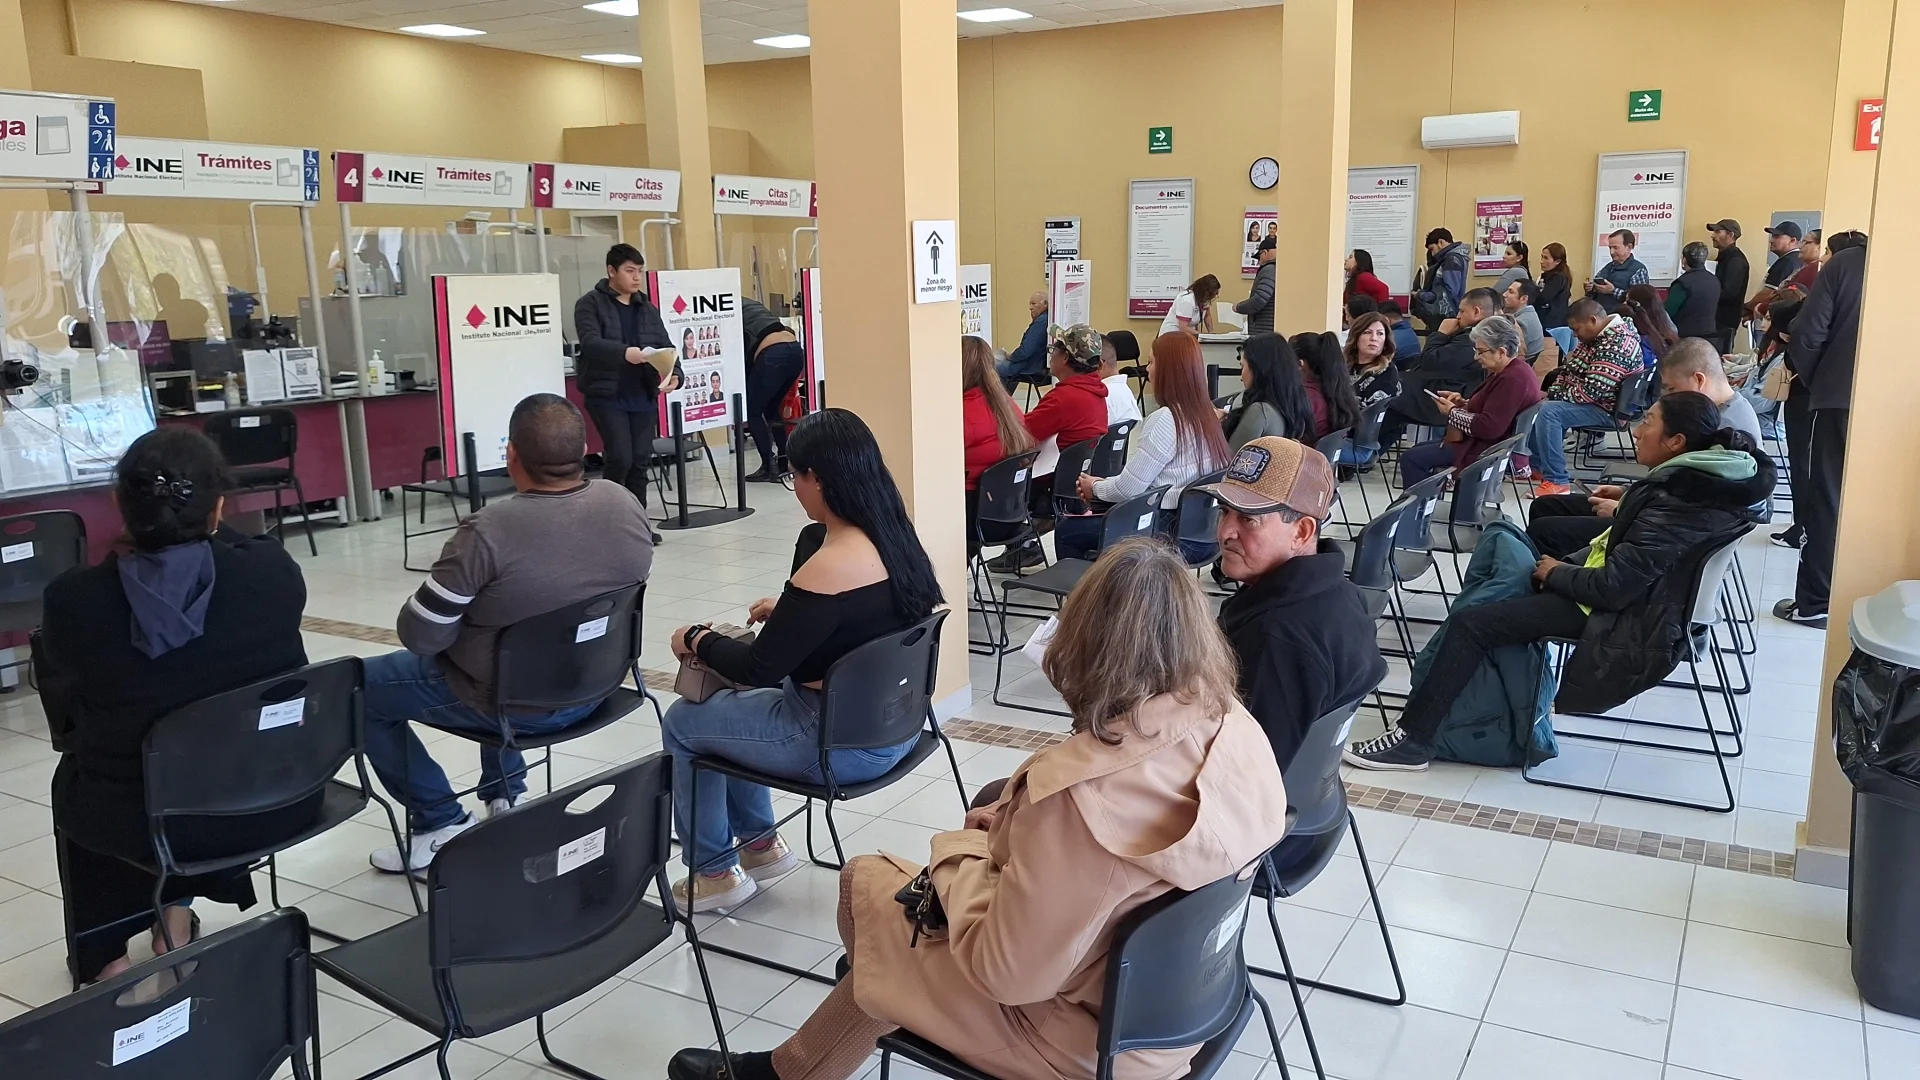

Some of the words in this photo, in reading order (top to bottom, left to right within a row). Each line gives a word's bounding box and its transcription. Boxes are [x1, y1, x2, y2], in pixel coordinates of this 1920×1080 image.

[136, 157, 183, 173] INE
[197, 153, 272, 170] Trámites
[344, 168, 358, 187] 4
[388, 169, 424, 184] INE
[437, 166, 492, 181] Trámites
[1646, 172, 1674, 181] INE
[539, 178, 550, 195] 3
[576, 181, 601, 192] INE
[635, 178, 663, 191] Citas
[1387, 178, 1408, 186] INE
[610, 192, 662, 201] programadas
[728, 188, 750, 200] INE
[768, 188, 788, 199] Citas
[750, 199, 788, 207] programadas
[1610, 211, 1672, 221] bienvenido
[1071, 264, 1085, 273] INE
[966, 282, 988, 299] INE
[693, 293, 734, 314] INE
[494, 304, 550, 328] INE
[461, 332, 491, 341] Instituto
[492, 329, 522, 338] Nacional
[127, 1031, 145, 1044] INE
